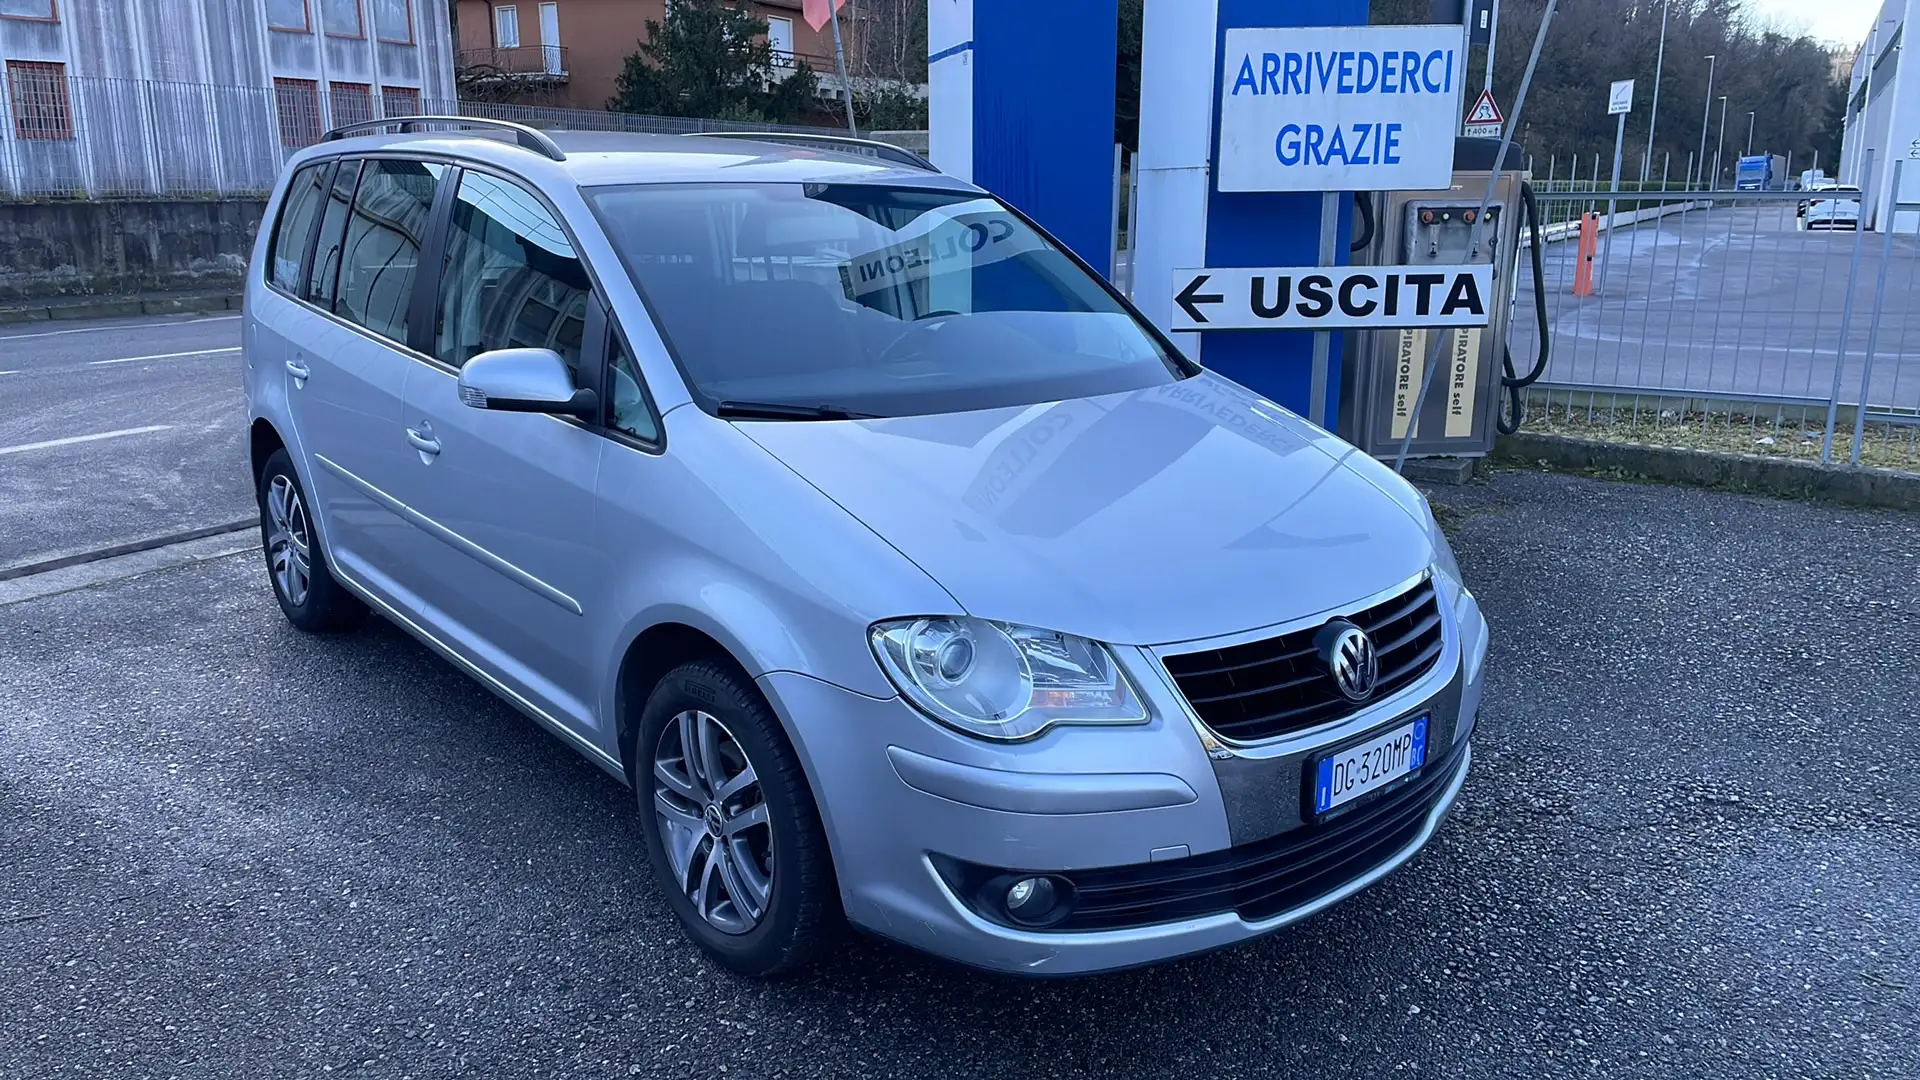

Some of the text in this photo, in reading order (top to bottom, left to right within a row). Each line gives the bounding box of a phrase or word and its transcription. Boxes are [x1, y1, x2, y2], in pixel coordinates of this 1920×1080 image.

[1232, 50, 1453, 96] ARRIVEDERCI
[1276, 123, 1402, 166] GRAZIE
[1250, 273, 1485, 318] USCITA
[1396, 394, 1407, 417] self
[1451, 392, 1462, 416] self
